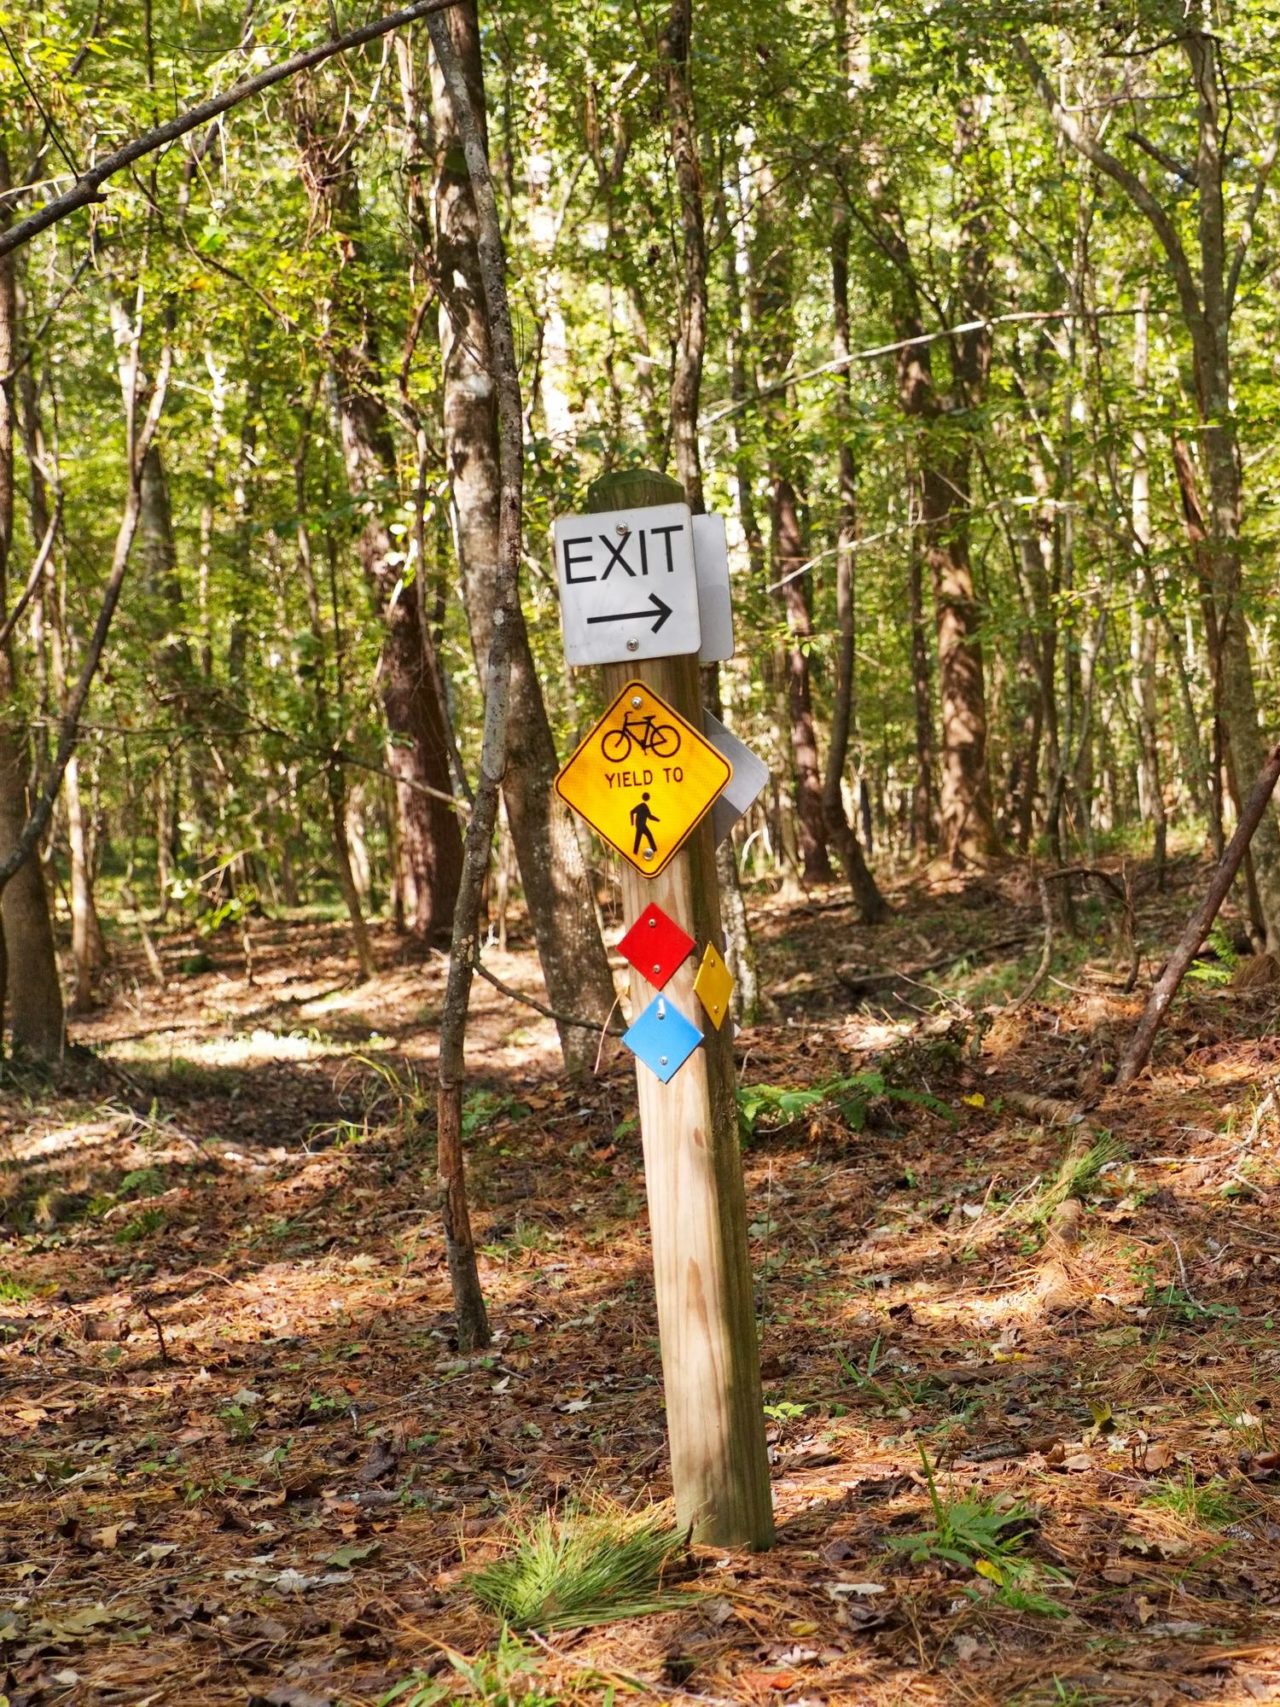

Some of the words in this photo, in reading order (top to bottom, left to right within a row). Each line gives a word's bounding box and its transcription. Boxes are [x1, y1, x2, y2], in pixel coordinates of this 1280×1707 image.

[563, 525, 684, 584] EXIT
[605, 769, 653, 789] YIELD
[663, 767, 684, 783] TO
